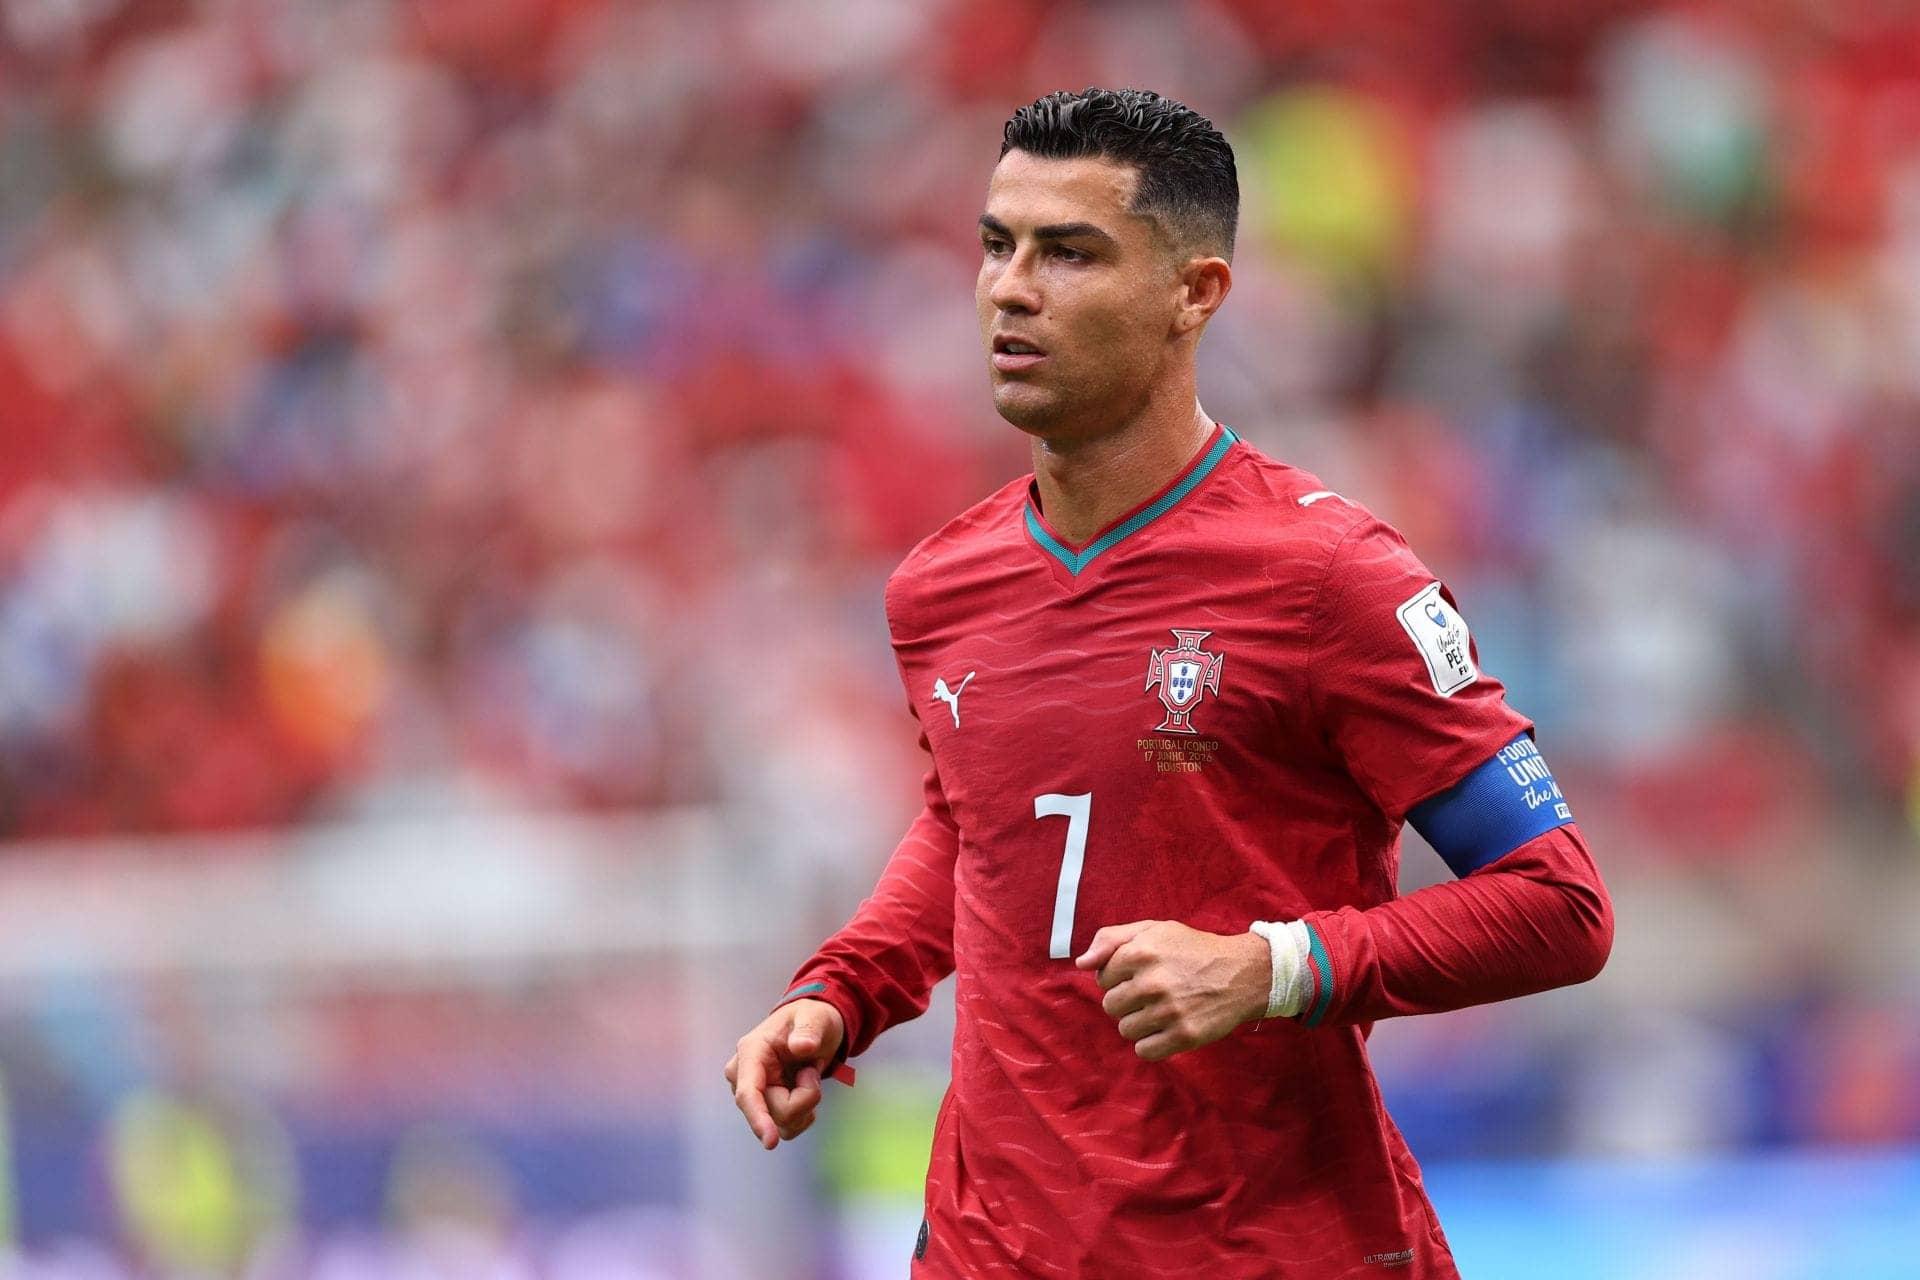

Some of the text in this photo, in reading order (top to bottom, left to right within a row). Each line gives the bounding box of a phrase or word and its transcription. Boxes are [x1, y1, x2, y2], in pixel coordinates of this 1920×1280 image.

[1137, 739, 1219, 752] PORTUGAL/CONGO
[1144, 750, 1213, 762] 17 JUNHO 2026
[1157, 762, 1202, 773] HOUSTON
[1520, 786, 1552, 810] the
[1034, 792, 1092, 959] 7
